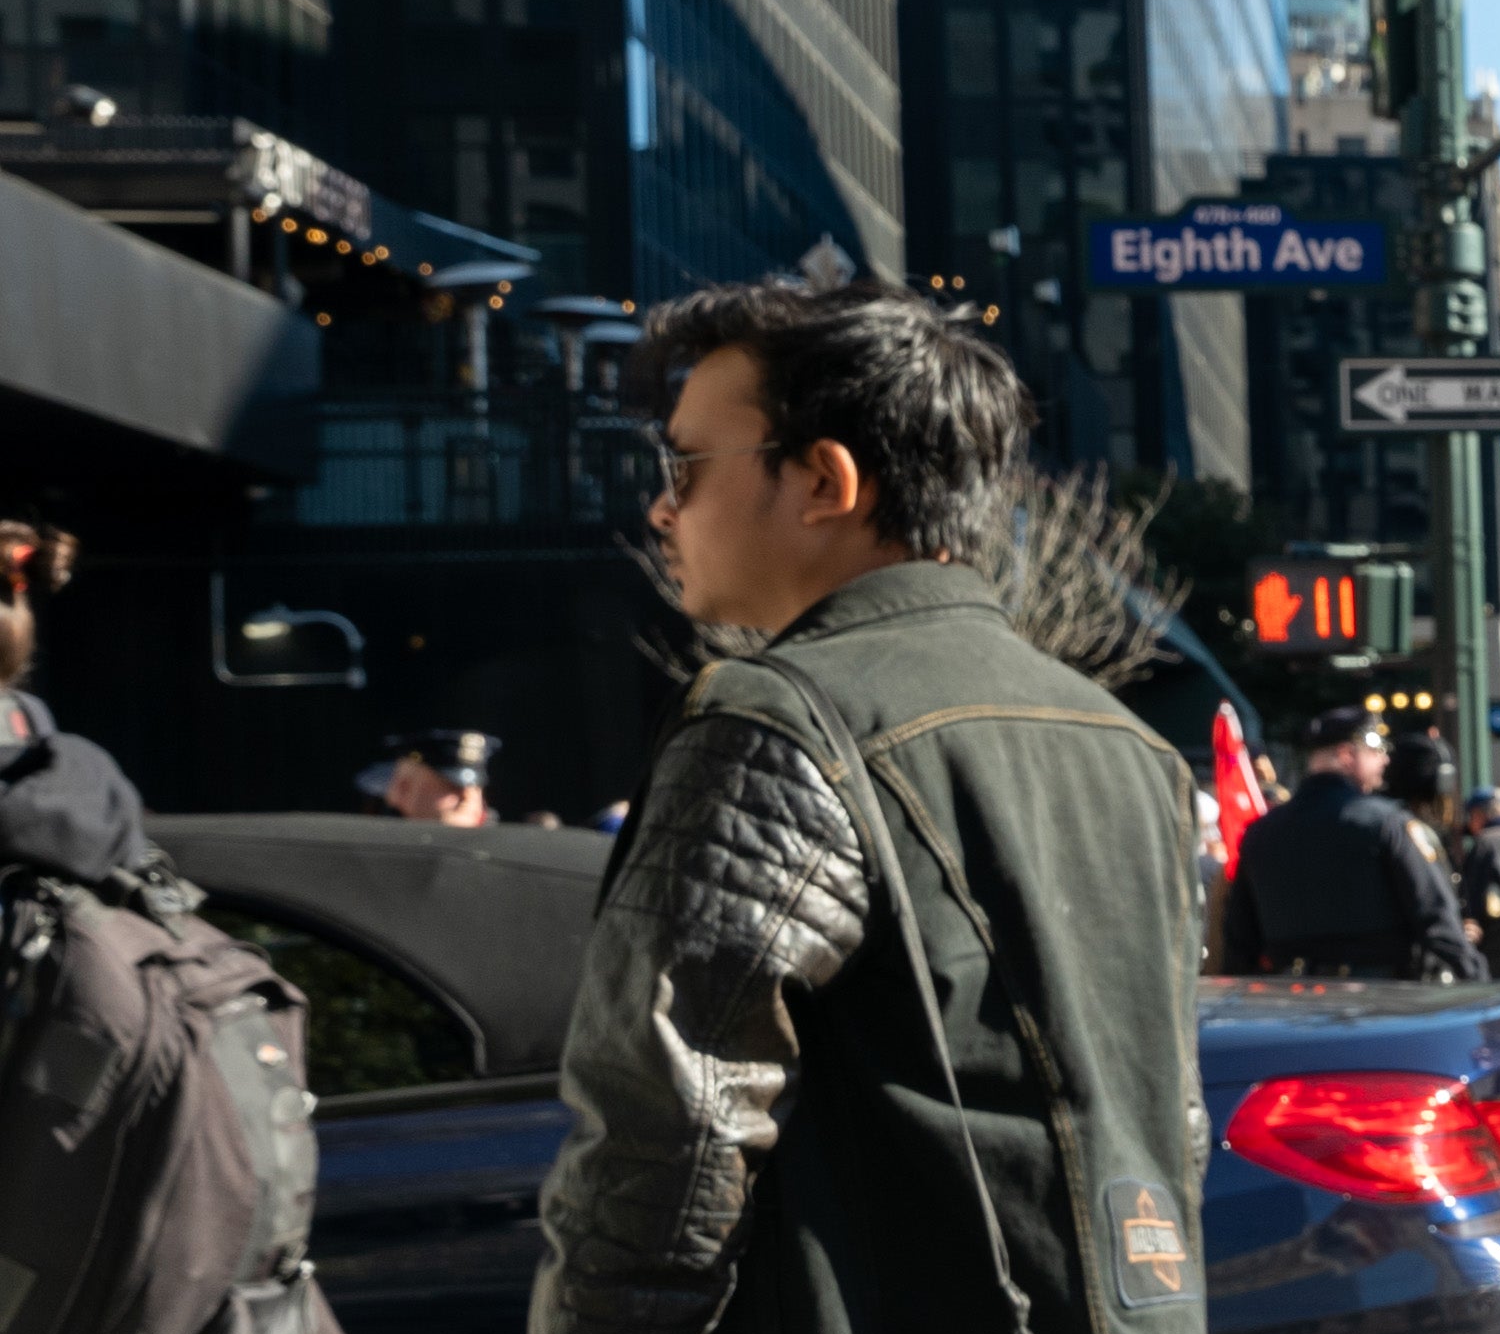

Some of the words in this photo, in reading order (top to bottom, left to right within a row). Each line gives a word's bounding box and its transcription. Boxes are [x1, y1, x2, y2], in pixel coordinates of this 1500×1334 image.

[1110, 226, 1262, 284] Eighth
[1272, 228, 1365, 273] Ave
[1376, 381, 1429, 406] ONE
[1314, 576, 1356, 639] 11
